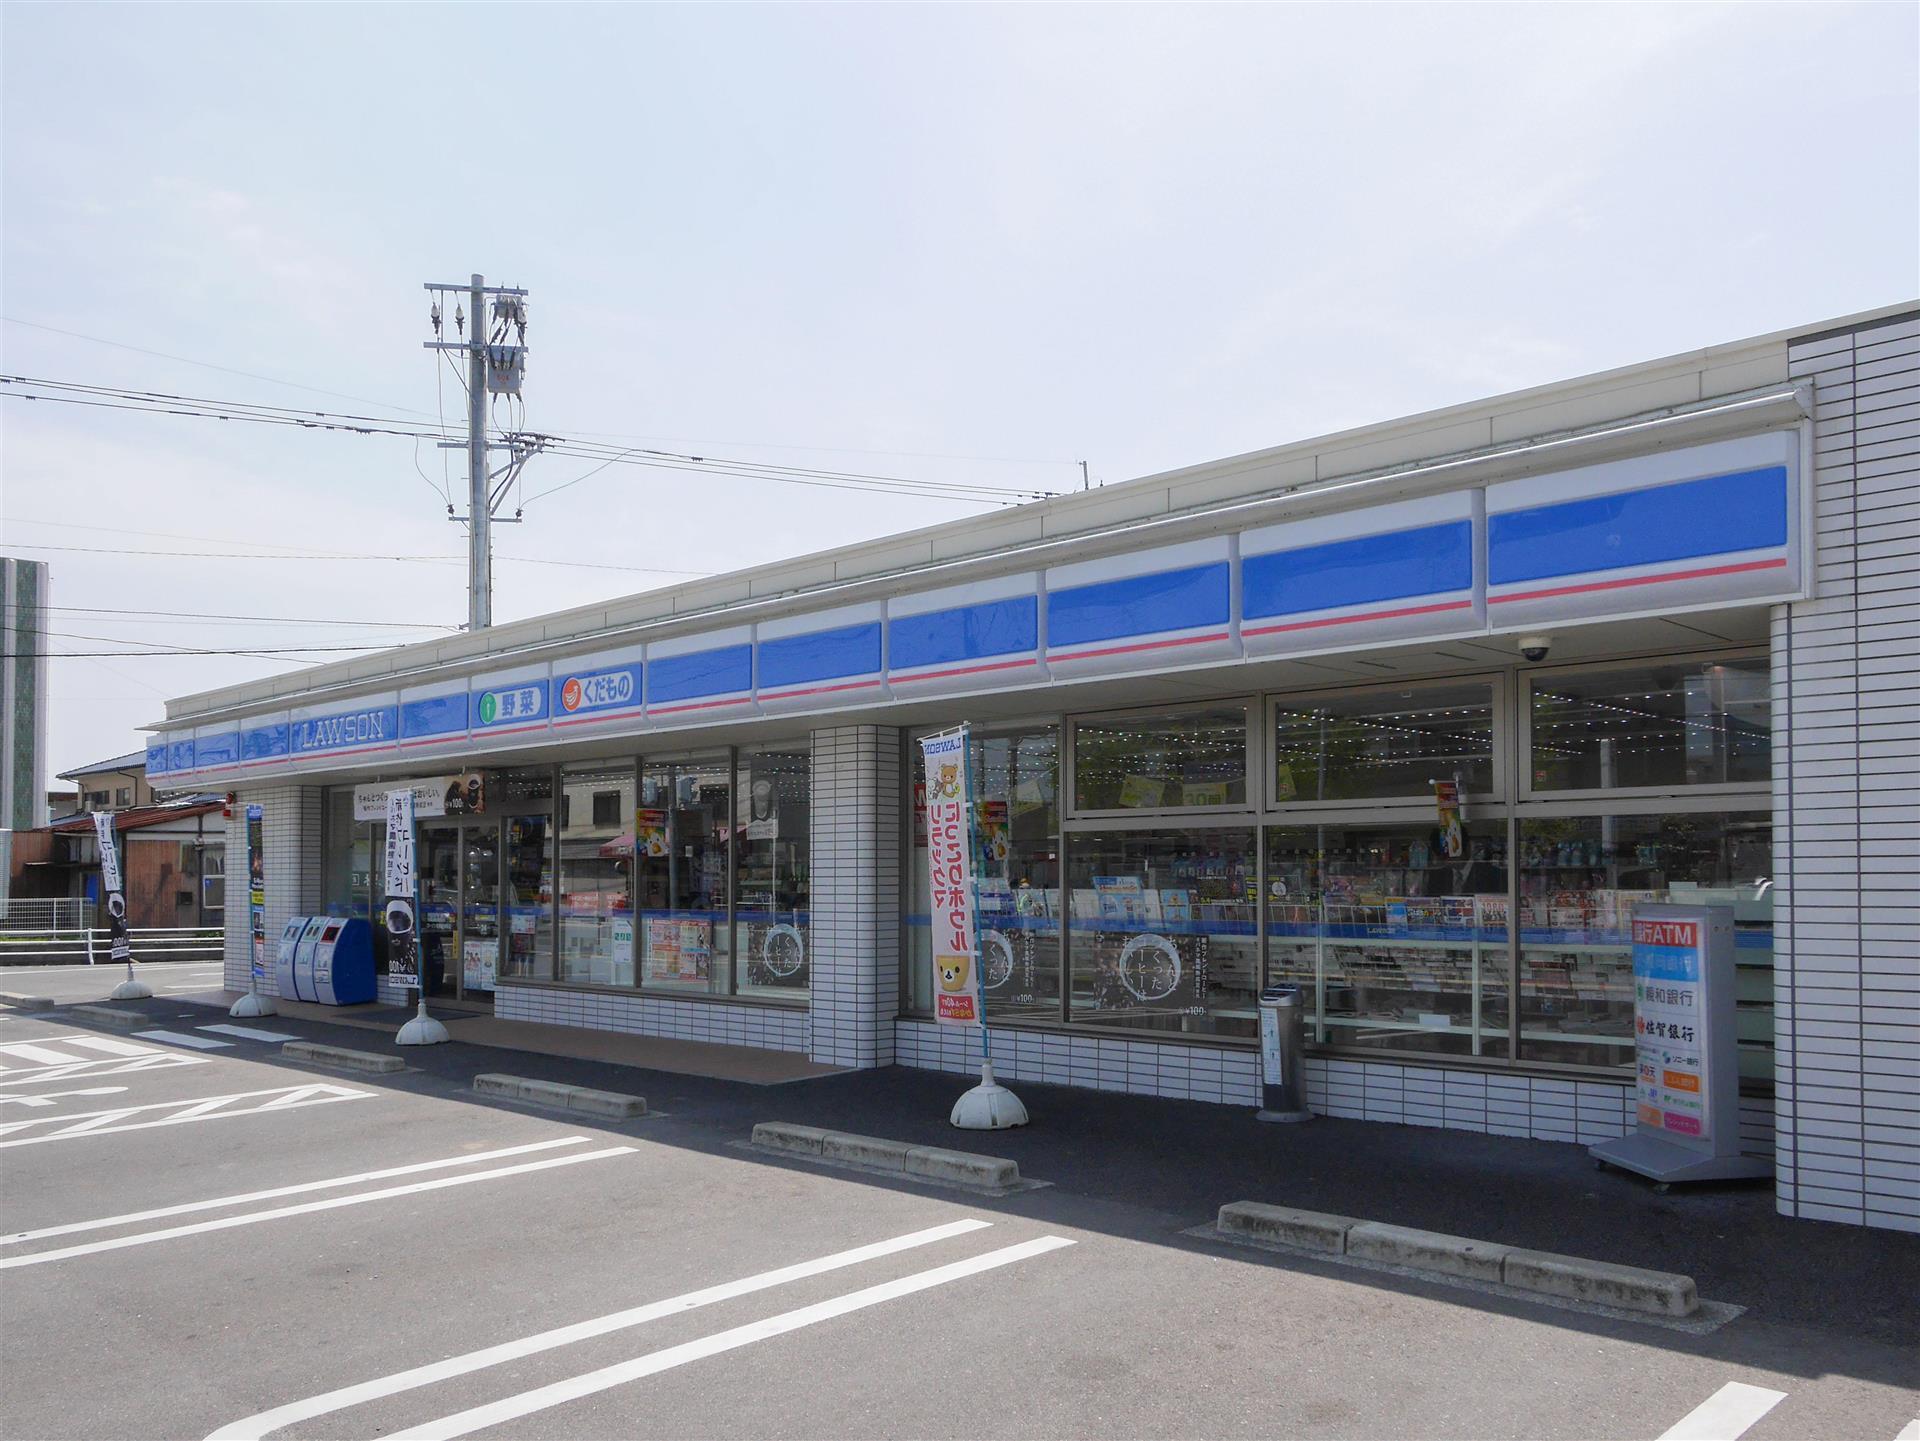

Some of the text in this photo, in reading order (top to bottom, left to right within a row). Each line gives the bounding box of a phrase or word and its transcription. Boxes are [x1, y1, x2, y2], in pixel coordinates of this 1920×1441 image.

[584, 675, 630, 703] くだもの
[502, 690, 534, 716] 野菜
[303, 712, 384, 748] LAWSON
[1646, 1021, 1695, 1043] 佐賀銀行
